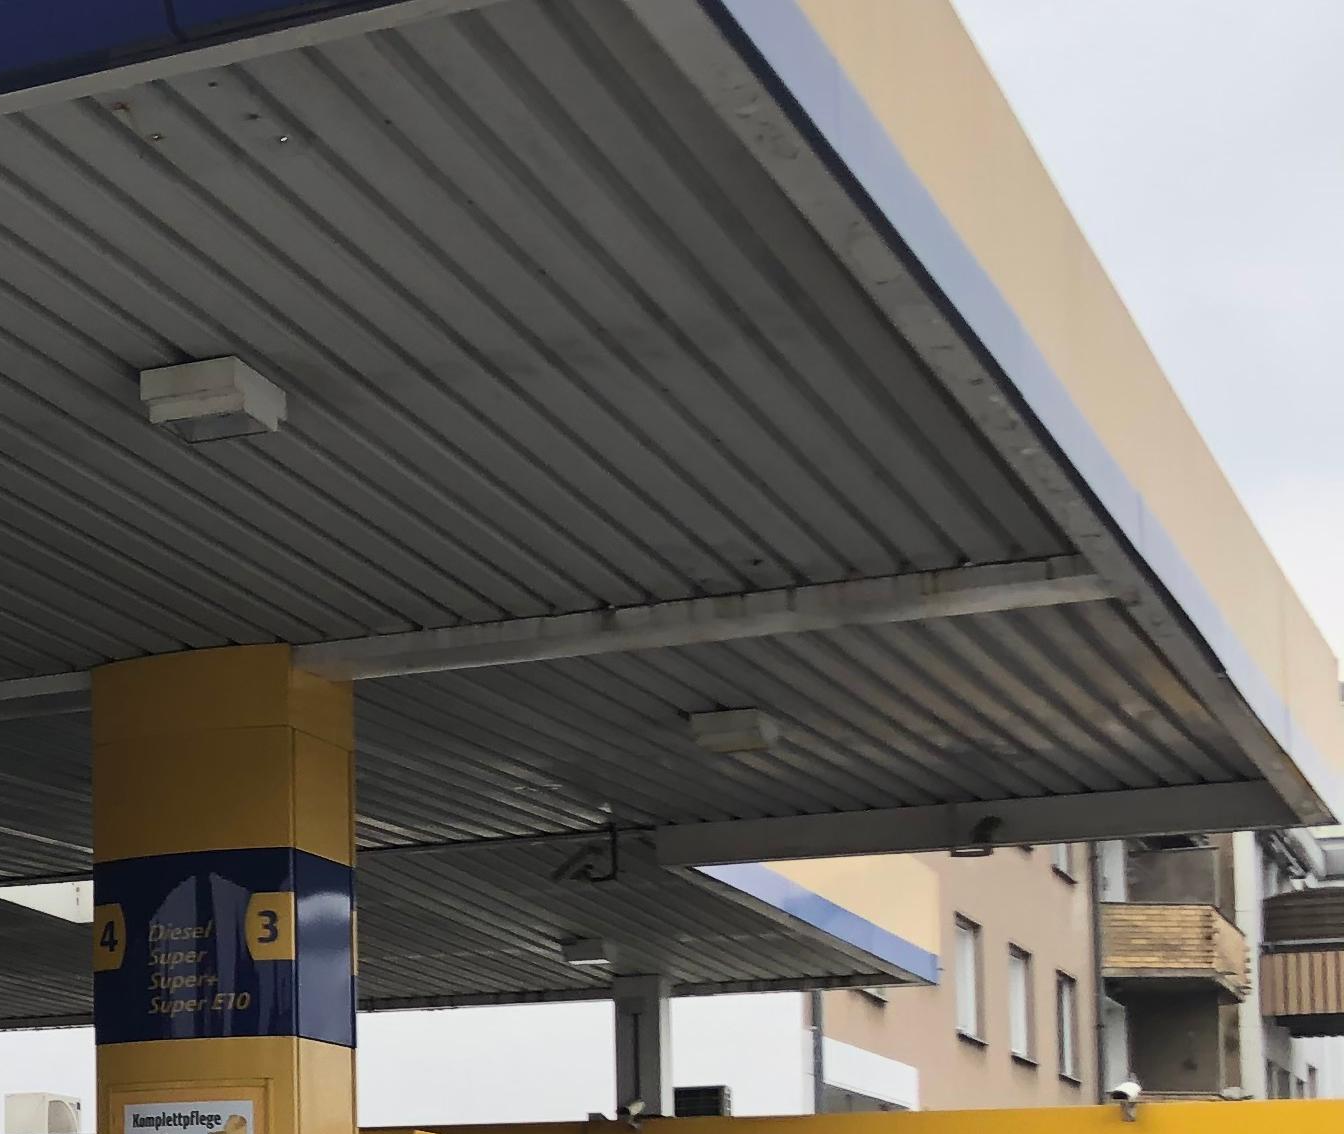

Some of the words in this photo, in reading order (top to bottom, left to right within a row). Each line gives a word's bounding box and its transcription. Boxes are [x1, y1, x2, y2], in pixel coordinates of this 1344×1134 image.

[100, 920, 118, 952] 4
[148, 920, 211, 942] Diesel
[257, 910, 278, 943] 3
[148, 950, 208, 969] Super
[148, 997, 208, 1016] Super
[212, 992, 250, 1010] E10
[132, 1111, 222, 1130] Komplettpflege
